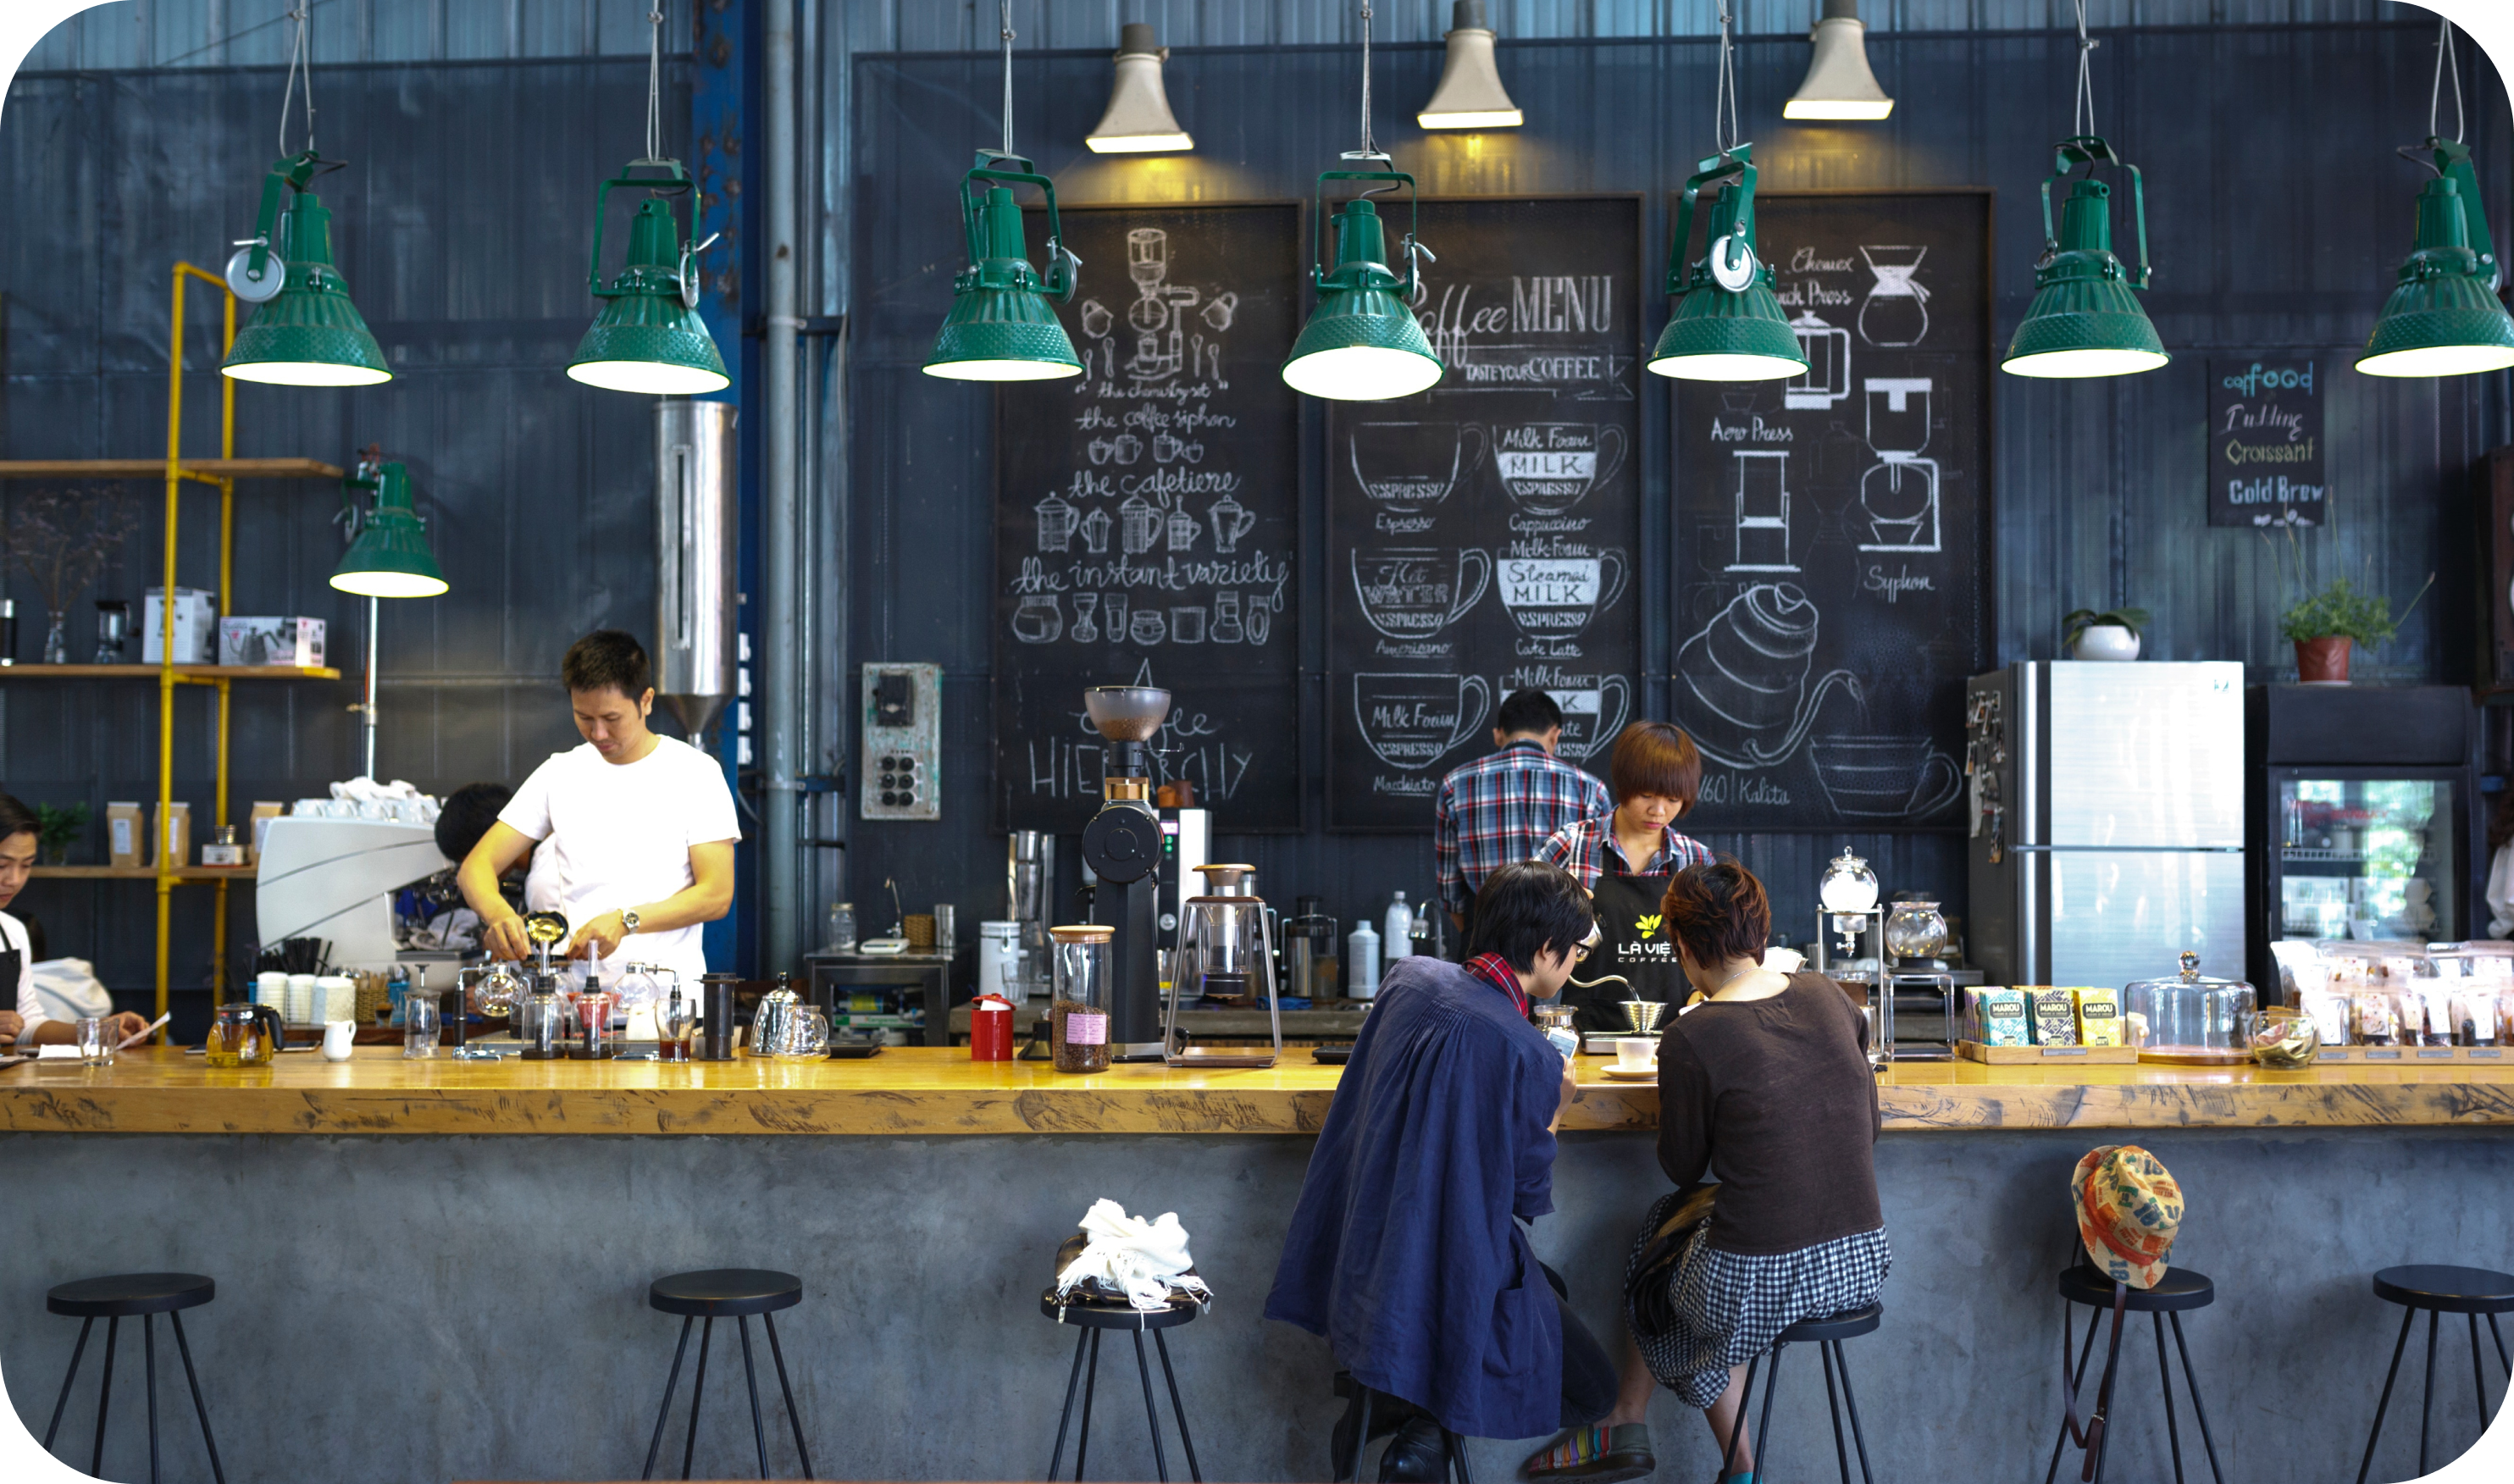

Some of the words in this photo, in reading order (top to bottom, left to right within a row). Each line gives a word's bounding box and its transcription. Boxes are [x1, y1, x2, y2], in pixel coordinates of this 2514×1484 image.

[1791, 246, 1854, 272] Chemex
[1808, 278, 1854, 306] Press
[1511, 275, 1612, 332] MENU
[1529, 356, 1600, 381] COFFEE
[1098, 381, 1125, 398] the
[1075, 406, 1117, 430] the
[1123, 402, 1170, 433] coffee
[1173, 403, 1237, 434] siphon
[1503, 426, 1543, 450] Milk
[1548, 426, 1592, 449] Foam
[1711, 418, 1747, 442] Aero
[1752, 417, 1793, 441] Press
[2225, 436, 2313, 465] Croissant
[1511, 455, 1582, 474] MILK
[1068, 470, 1116, 499] the
[1368, 482, 1445, 500] ESPRESSO
[1512, 480, 1581, 496] ESPRESSO
[2229, 477, 2273, 505] Cold
[2277, 475, 2324, 502] Brew
[1510, 536, 1551, 559] Milk
[1011, 556, 1069, 594] the
[1068, 553, 1186, 591] instant
[1182, 550, 1290, 612] variety
[1508, 562, 1589, 584] Steamed
[1863, 564, 1935, 603] Syphon
[1362, 584, 1449, 605] WATER
[1513, 584, 1581, 603] MILK
[1375, 612, 1444, 628] ESPRESSO
[1517, 612, 1586, 628] ESPRESSO
[1375, 639, 1454, 656] Americano
[1548, 636, 1583, 658] Latte
[1514, 665, 1552, 688] Milk
[1371, 704, 1409, 729] Milk
[1413, 703, 1456, 728] Foam
[1376, 741, 1443, 758] ESPRESSO
[1739, 776, 1791, 806] Kalita
[1618, 940, 1642, 955] LÀ
[1644, 940, 1677, 957] VIỆ
[1992, 1003, 2020, 1012] MAROU
[2040, 1003, 2068, 1012] MAROU
[2085, 1004, 2113, 1013] MAROU
